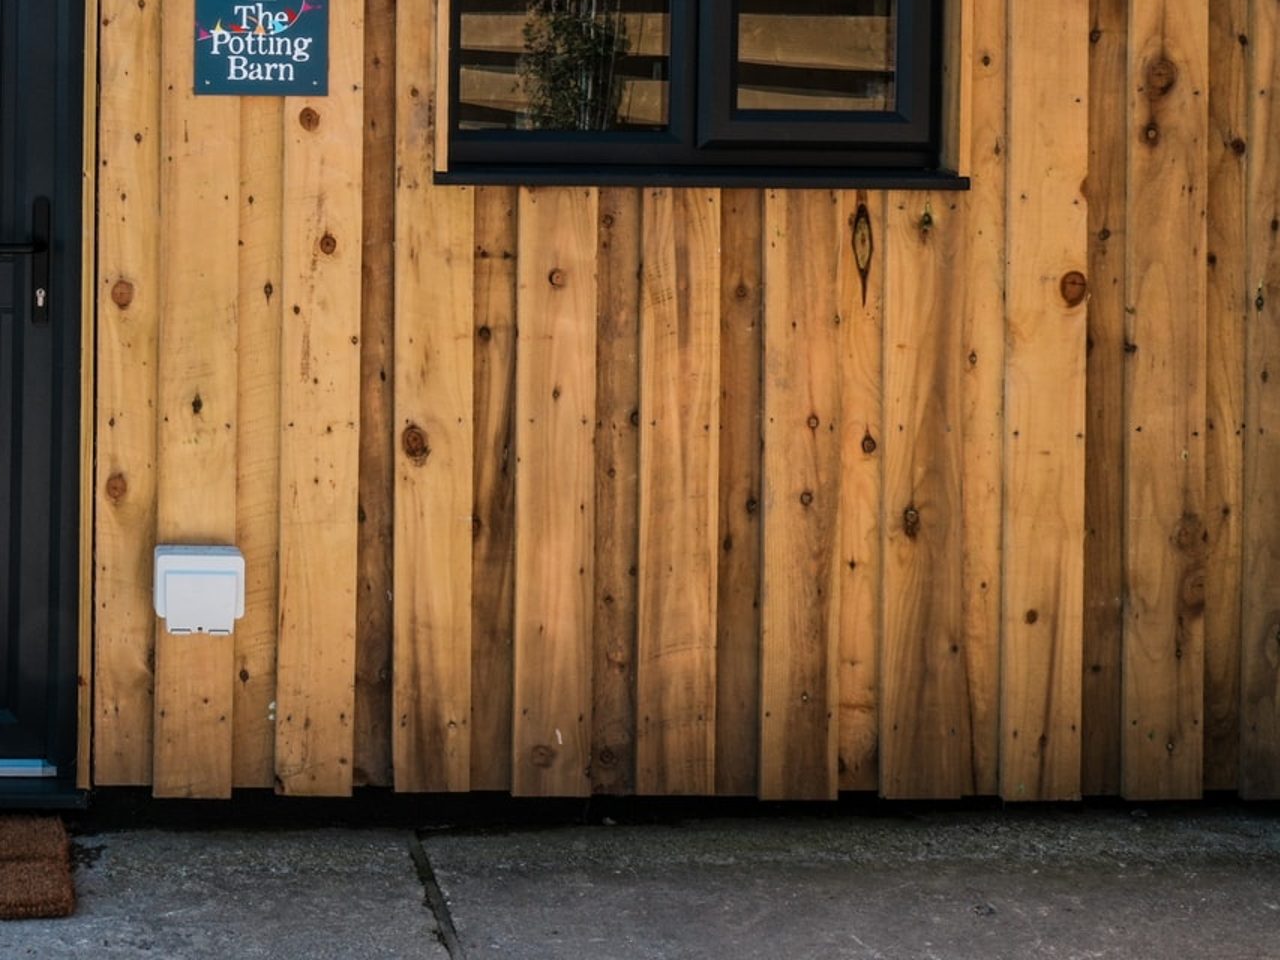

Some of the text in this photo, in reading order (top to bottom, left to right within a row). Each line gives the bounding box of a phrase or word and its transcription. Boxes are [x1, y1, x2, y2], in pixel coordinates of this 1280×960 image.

[234, 2, 288, 30] The
[209, 29, 313, 62] Potting
[227, 56, 295, 82] Barn
